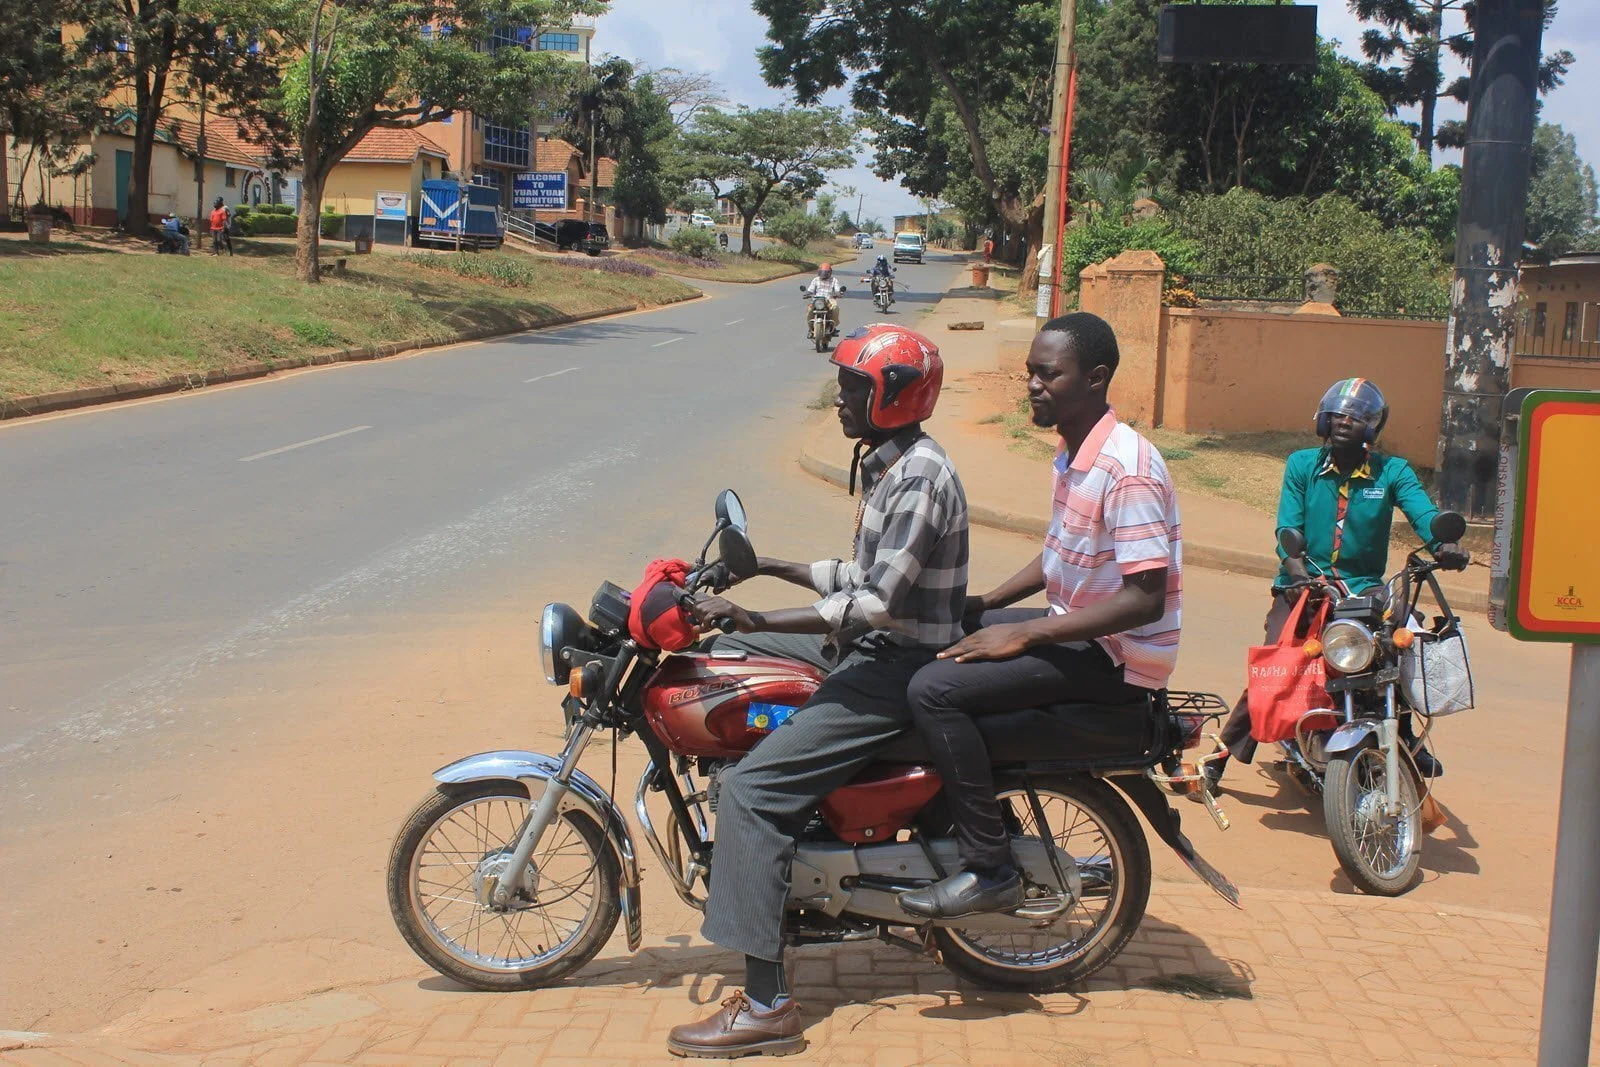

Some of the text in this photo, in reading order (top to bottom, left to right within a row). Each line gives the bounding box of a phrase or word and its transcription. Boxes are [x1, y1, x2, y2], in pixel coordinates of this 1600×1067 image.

[532, 181, 545, 189] TO
[514, 189, 565, 197] YUAN YUAN
[1557, 597, 1582, 605] KCCA
